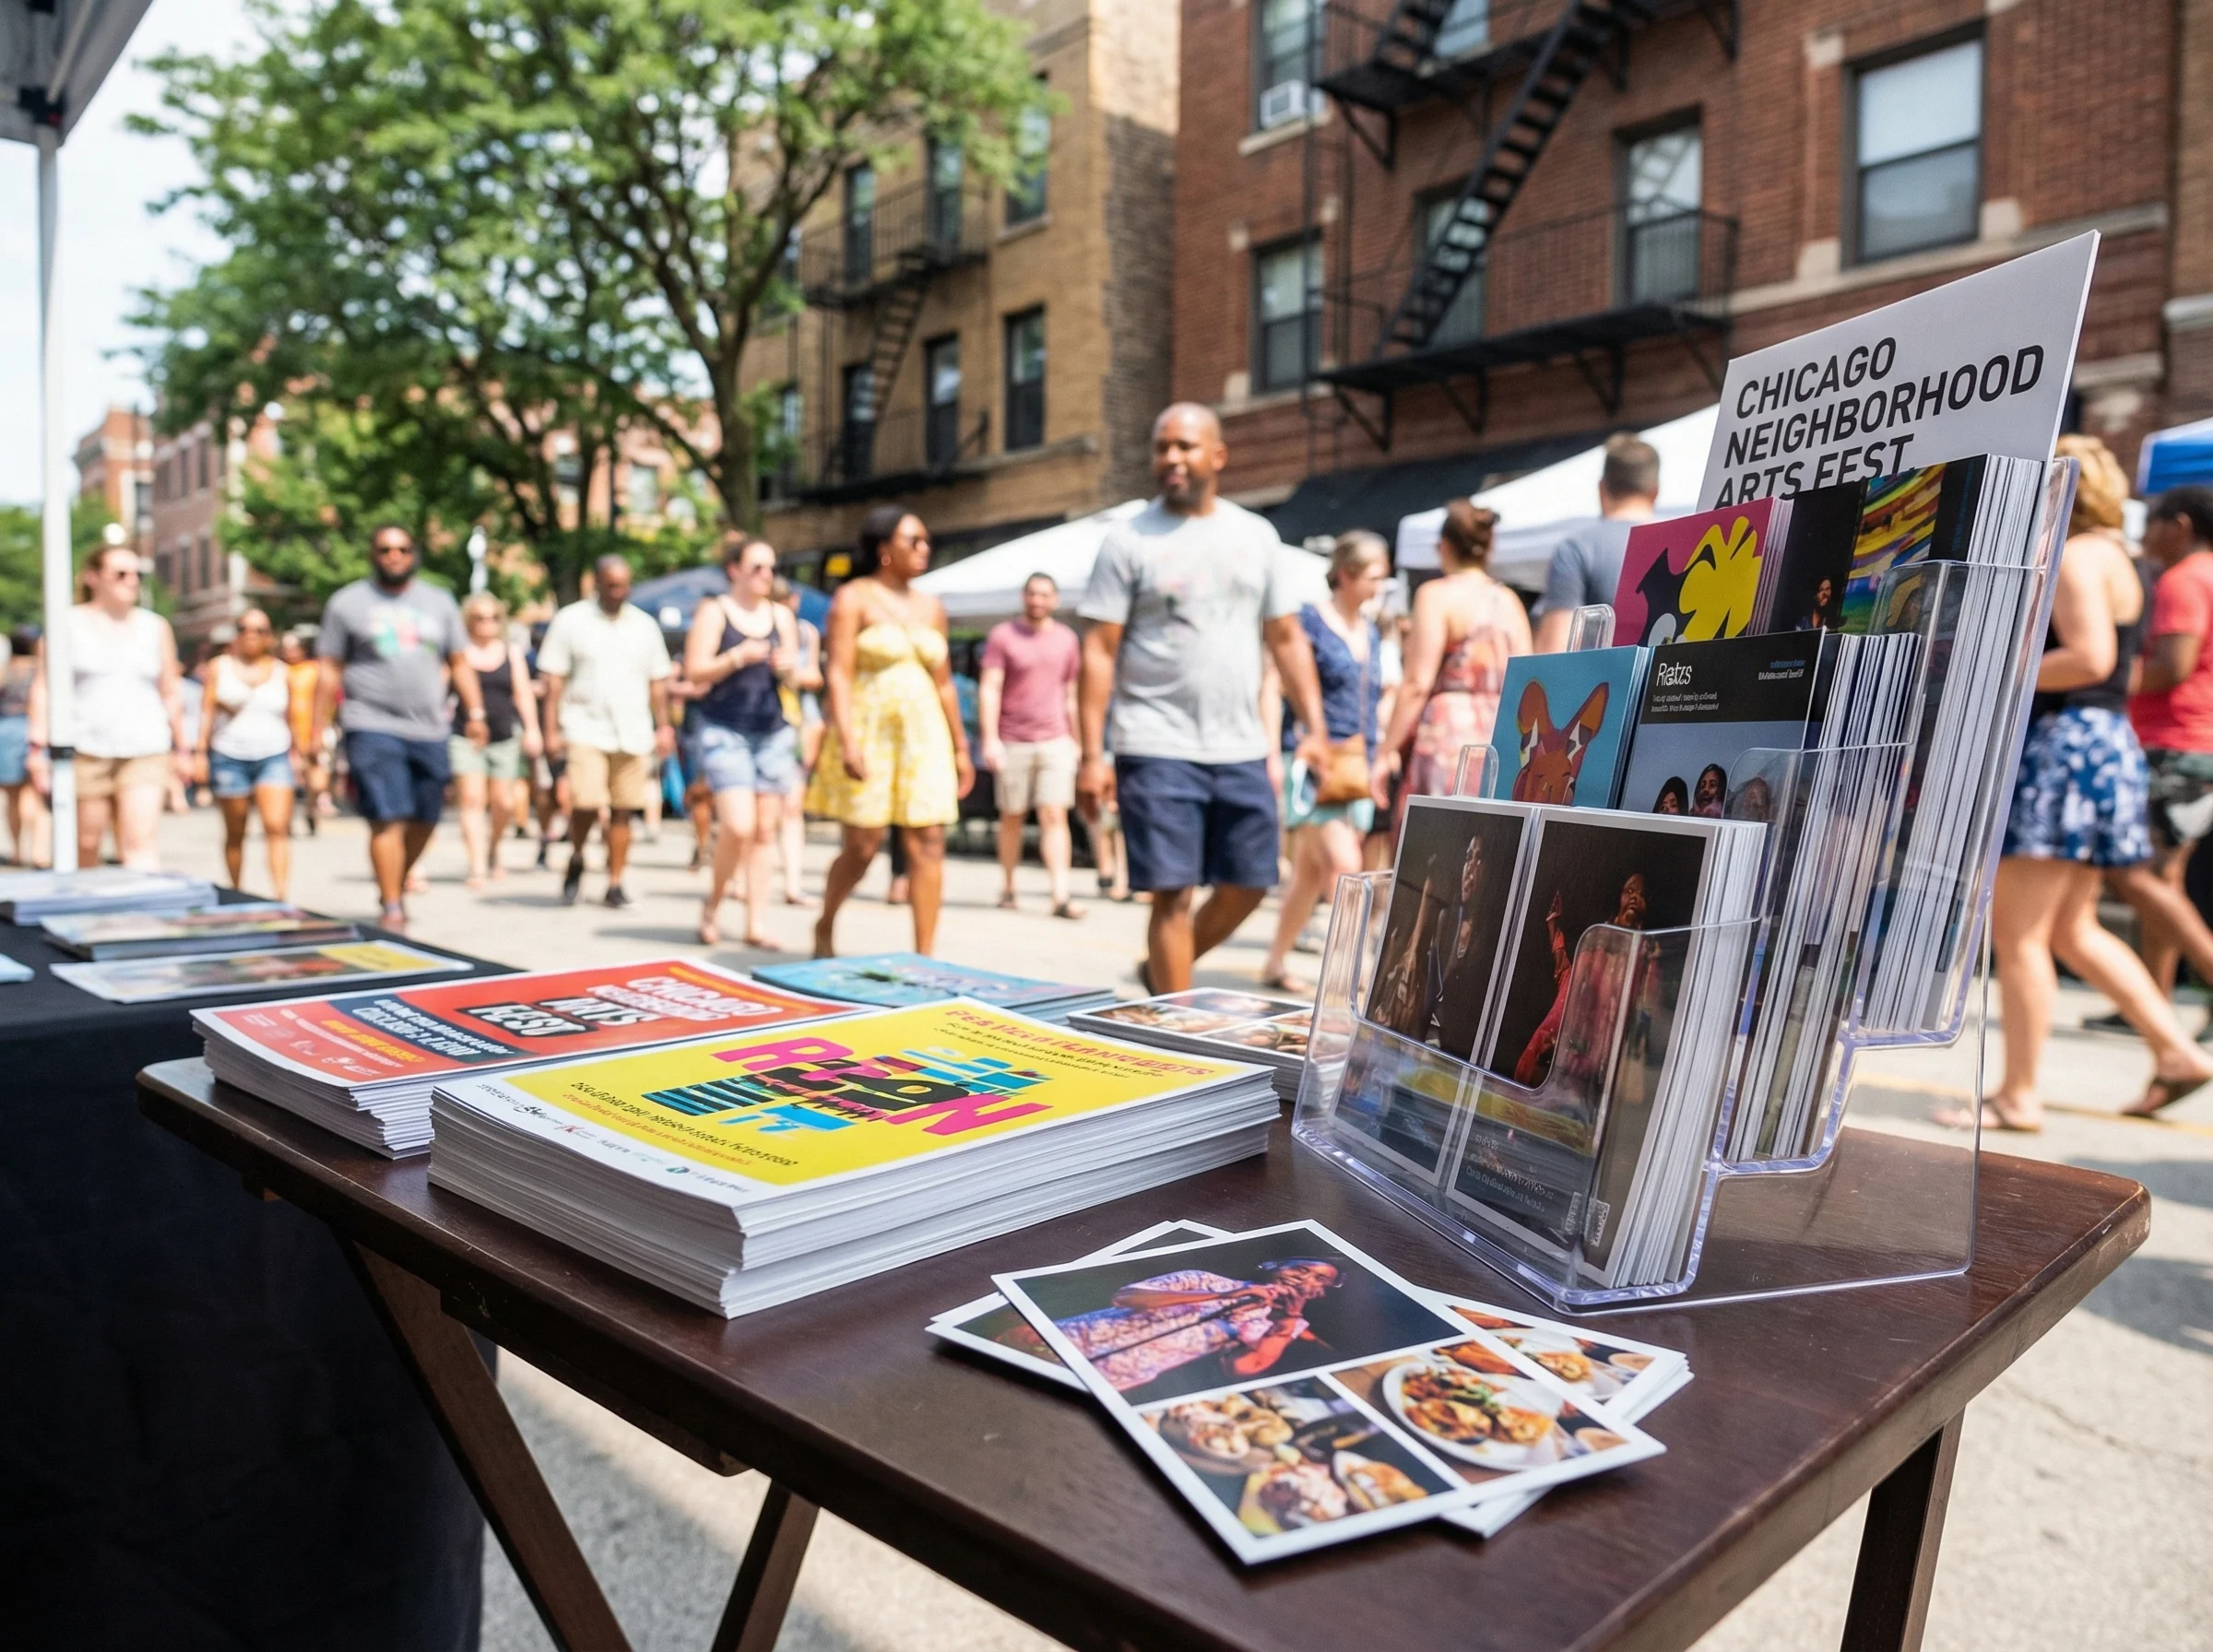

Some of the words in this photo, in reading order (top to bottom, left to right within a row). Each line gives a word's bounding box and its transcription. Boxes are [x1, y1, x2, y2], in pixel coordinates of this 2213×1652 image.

[1723, 345, 2044, 469] NEIGHBORHOOD
[1735, 336, 1897, 419] CHICAGO
[1713, 461, 1805, 511] ARTS
[1813, 432, 1915, 490] FEST
[468, 1003, 587, 1037] FEST
